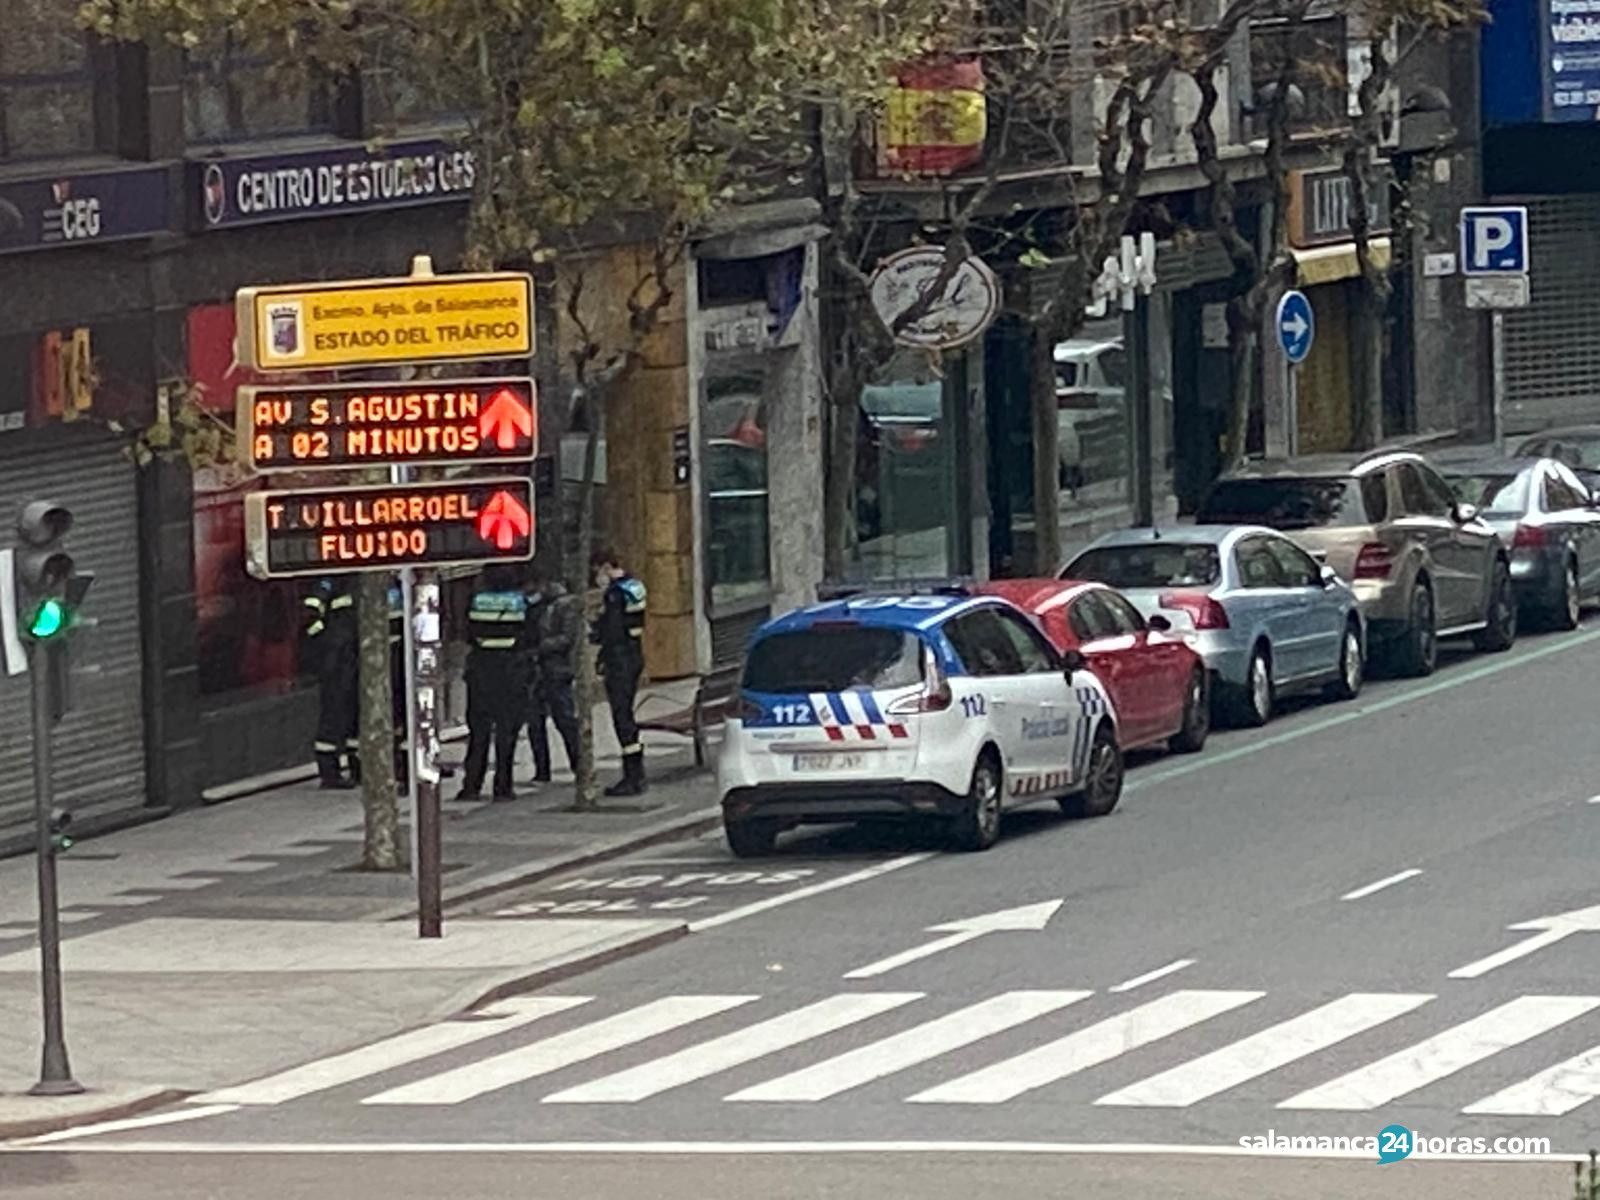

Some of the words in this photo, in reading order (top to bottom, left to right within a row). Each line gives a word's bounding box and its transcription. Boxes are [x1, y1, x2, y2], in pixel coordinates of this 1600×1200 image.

[237, 167, 314, 213] CENTRO
[317, 164, 344, 205] DE
[62, 197, 100, 240] CEG
[1474, 217, 1513, 267] P
[414, 299, 432, 314] de
[314, 328, 389, 350] ESTADO
[395, 327, 431, 345] DEL
[437, 319, 520, 342] TRÁFICO
[255, 400, 292, 426] AV
[255, 433, 273, 459] A
[293, 431, 330, 458] 02
[348, 426, 479, 456] MINUTOS
[321, 529, 428, 561] FLUIDO
[772, 704, 811, 723] 112
[960, 693, 987, 718] 112
